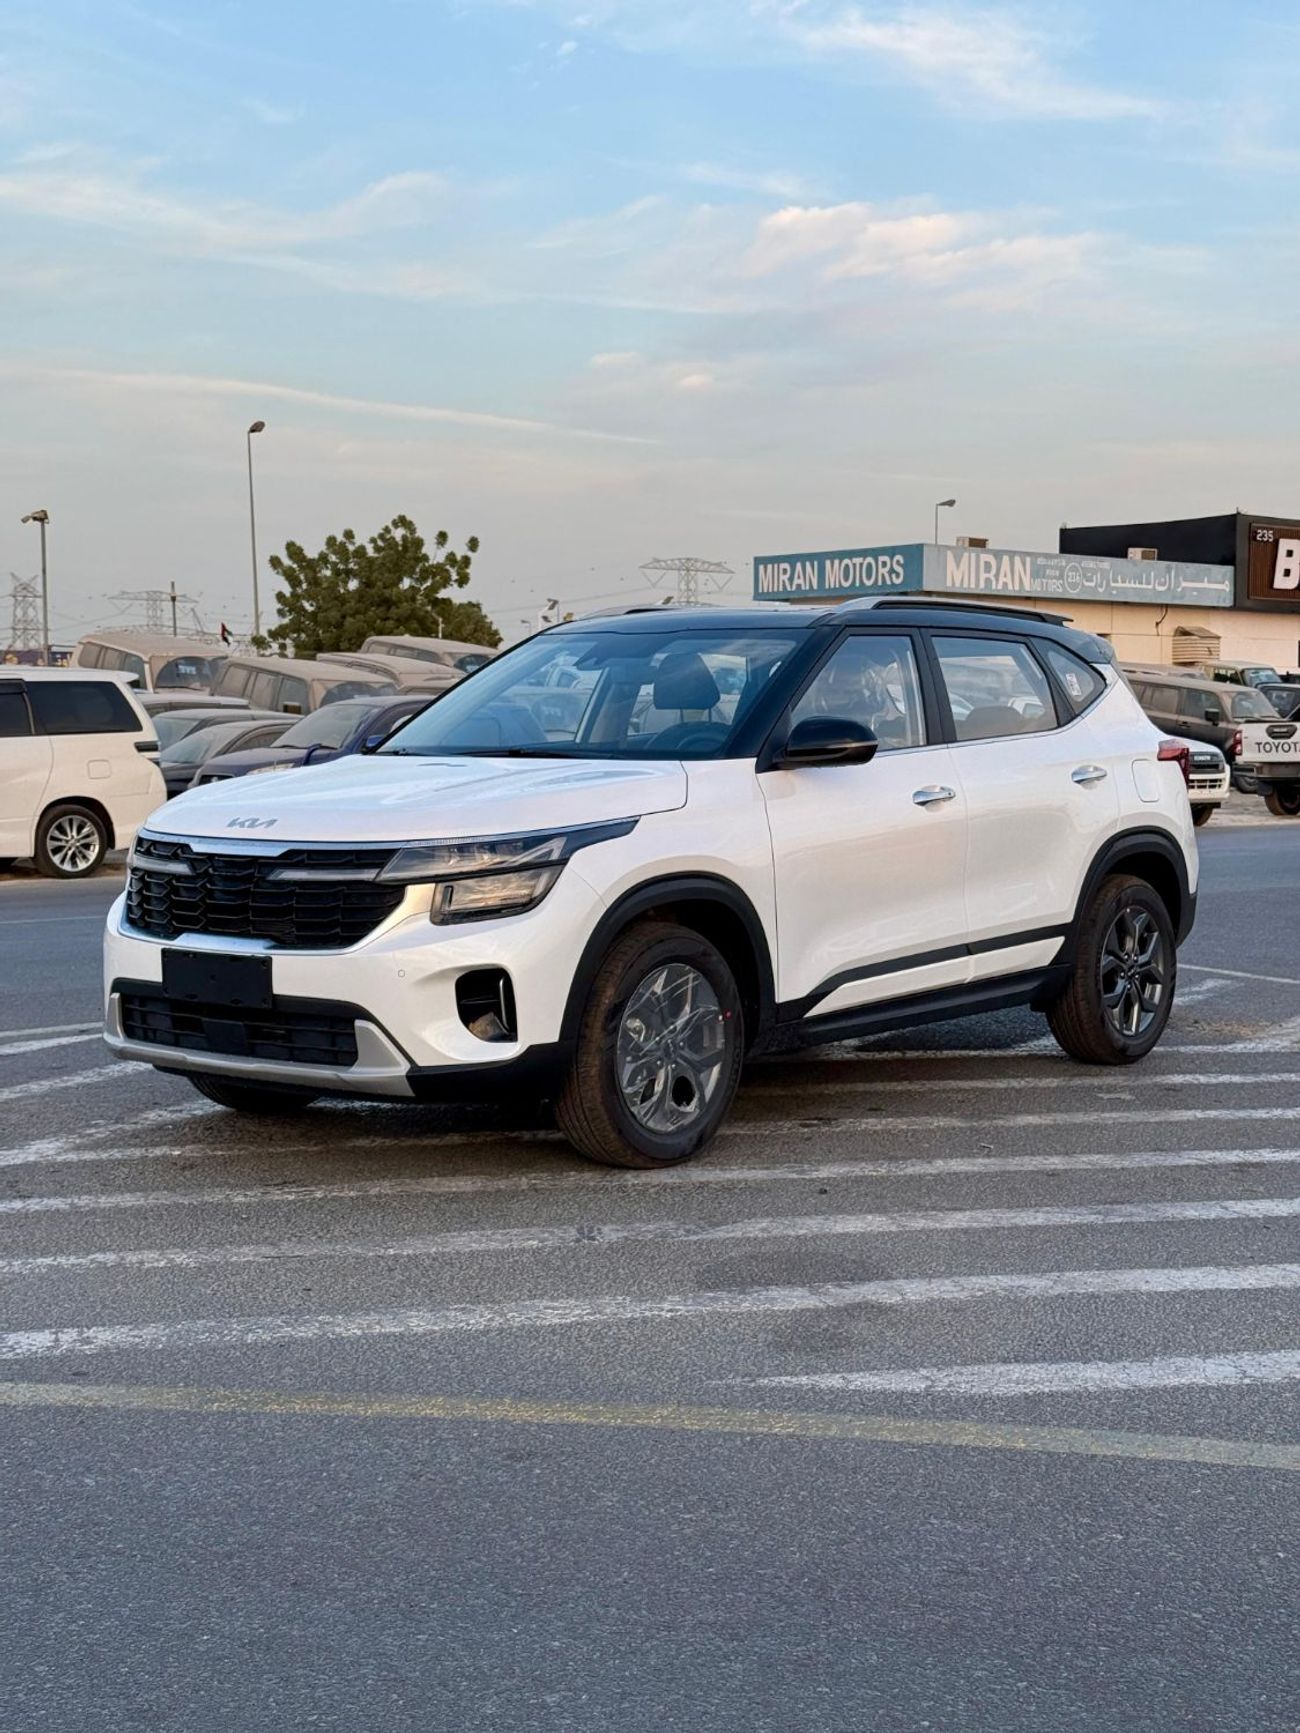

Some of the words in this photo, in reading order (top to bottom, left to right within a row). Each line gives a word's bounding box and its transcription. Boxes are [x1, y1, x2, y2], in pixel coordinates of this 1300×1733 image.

[1256, 529, 1274, 542] 235
[758, 561, 818, 593] MIRAN
[825, 555, 904, 589] MOTORS
[946, 551, 1031, 591] MIRAN
[1255, 741, 1300, 753] TOYOT
